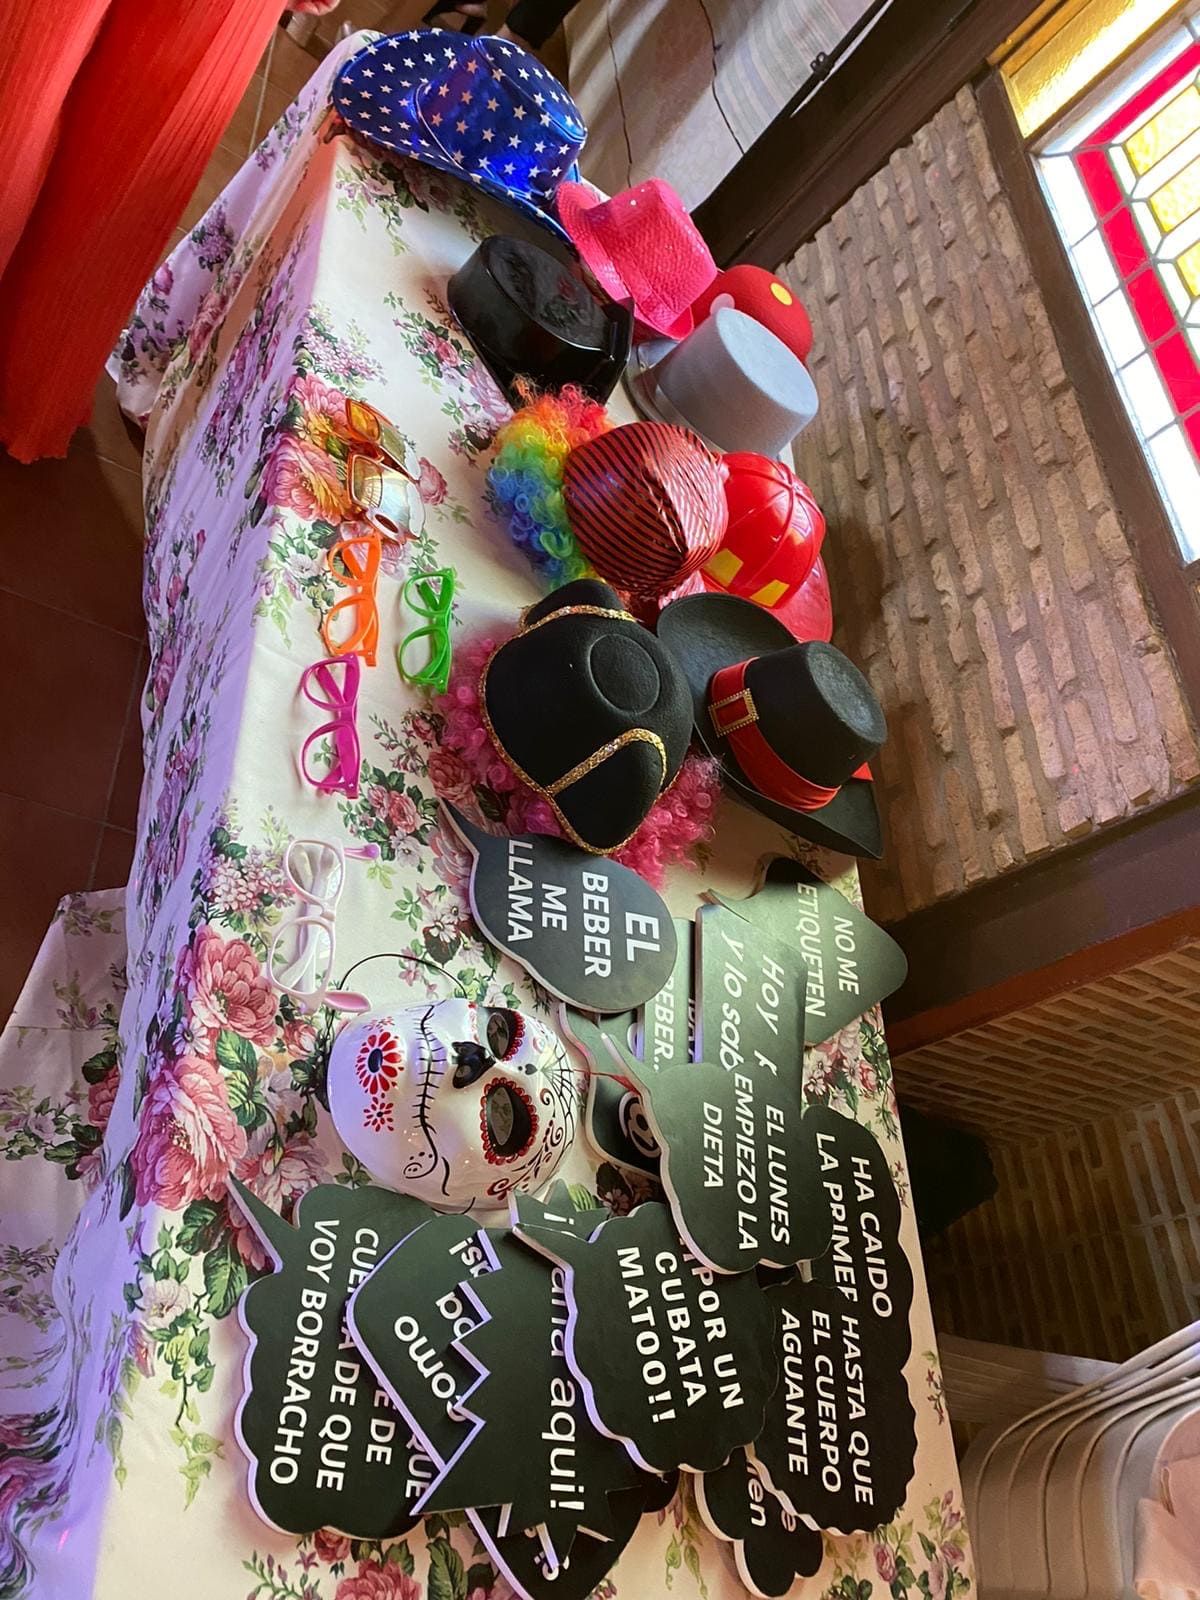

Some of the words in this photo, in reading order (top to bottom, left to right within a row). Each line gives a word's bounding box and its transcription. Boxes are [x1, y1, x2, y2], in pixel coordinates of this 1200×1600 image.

[507, 839, 533, 943] LLAMA
[541, 882, 568, 932] ME
[582, 871, 612, 979] BEBER
[625, 912, 660, 962] EL
[797, 882, 826, 1017] ETIQUETEN
[833, 916, 855, 953] NO
[723, 962, 748, 998] lo
[758, 955, 785, 1036] Hoy
[836, 957, 859, 996] ME
[720, 1002, 746, 1072] sab
[703, 1102, 724, 1188] DIETA
[734, 1072, 757, 1204] EMPIEZO
[766, 1104, 785, 1137] EL
[816, 1132, 839, 1171] LA
[767, 1144, 790, 1246] LUNES
[851, 1156, 875, 1202] HA
[306, 1219, 341, 1283] VOY
[738, 1211, 758, 1250] LA
[859, 1212, 894, 1318] CAIDO
[617, 1246, 676, 1424] MATOO!!
[655, 1251, 707, 1408] CUBATA
[812, 1309, 831, 1346] EL
[269, 1288, 328, 1485] BORRACHO
[329, 1360, 360, 1407] DE
[713, 1353, 744, 1410] UN
[780, 1308, 809, 1476] AGUANTE
[841, 1314, 866, 1420] HASTA
[316, 1414, 351, 1492] QUE
[365, 1418, 396, 1465] DE
[541, 1377, 585, 1511] aqui!
[814, 1354, 842, 1493] CUERPO
[848, 1430, 875, 1506] QUE
